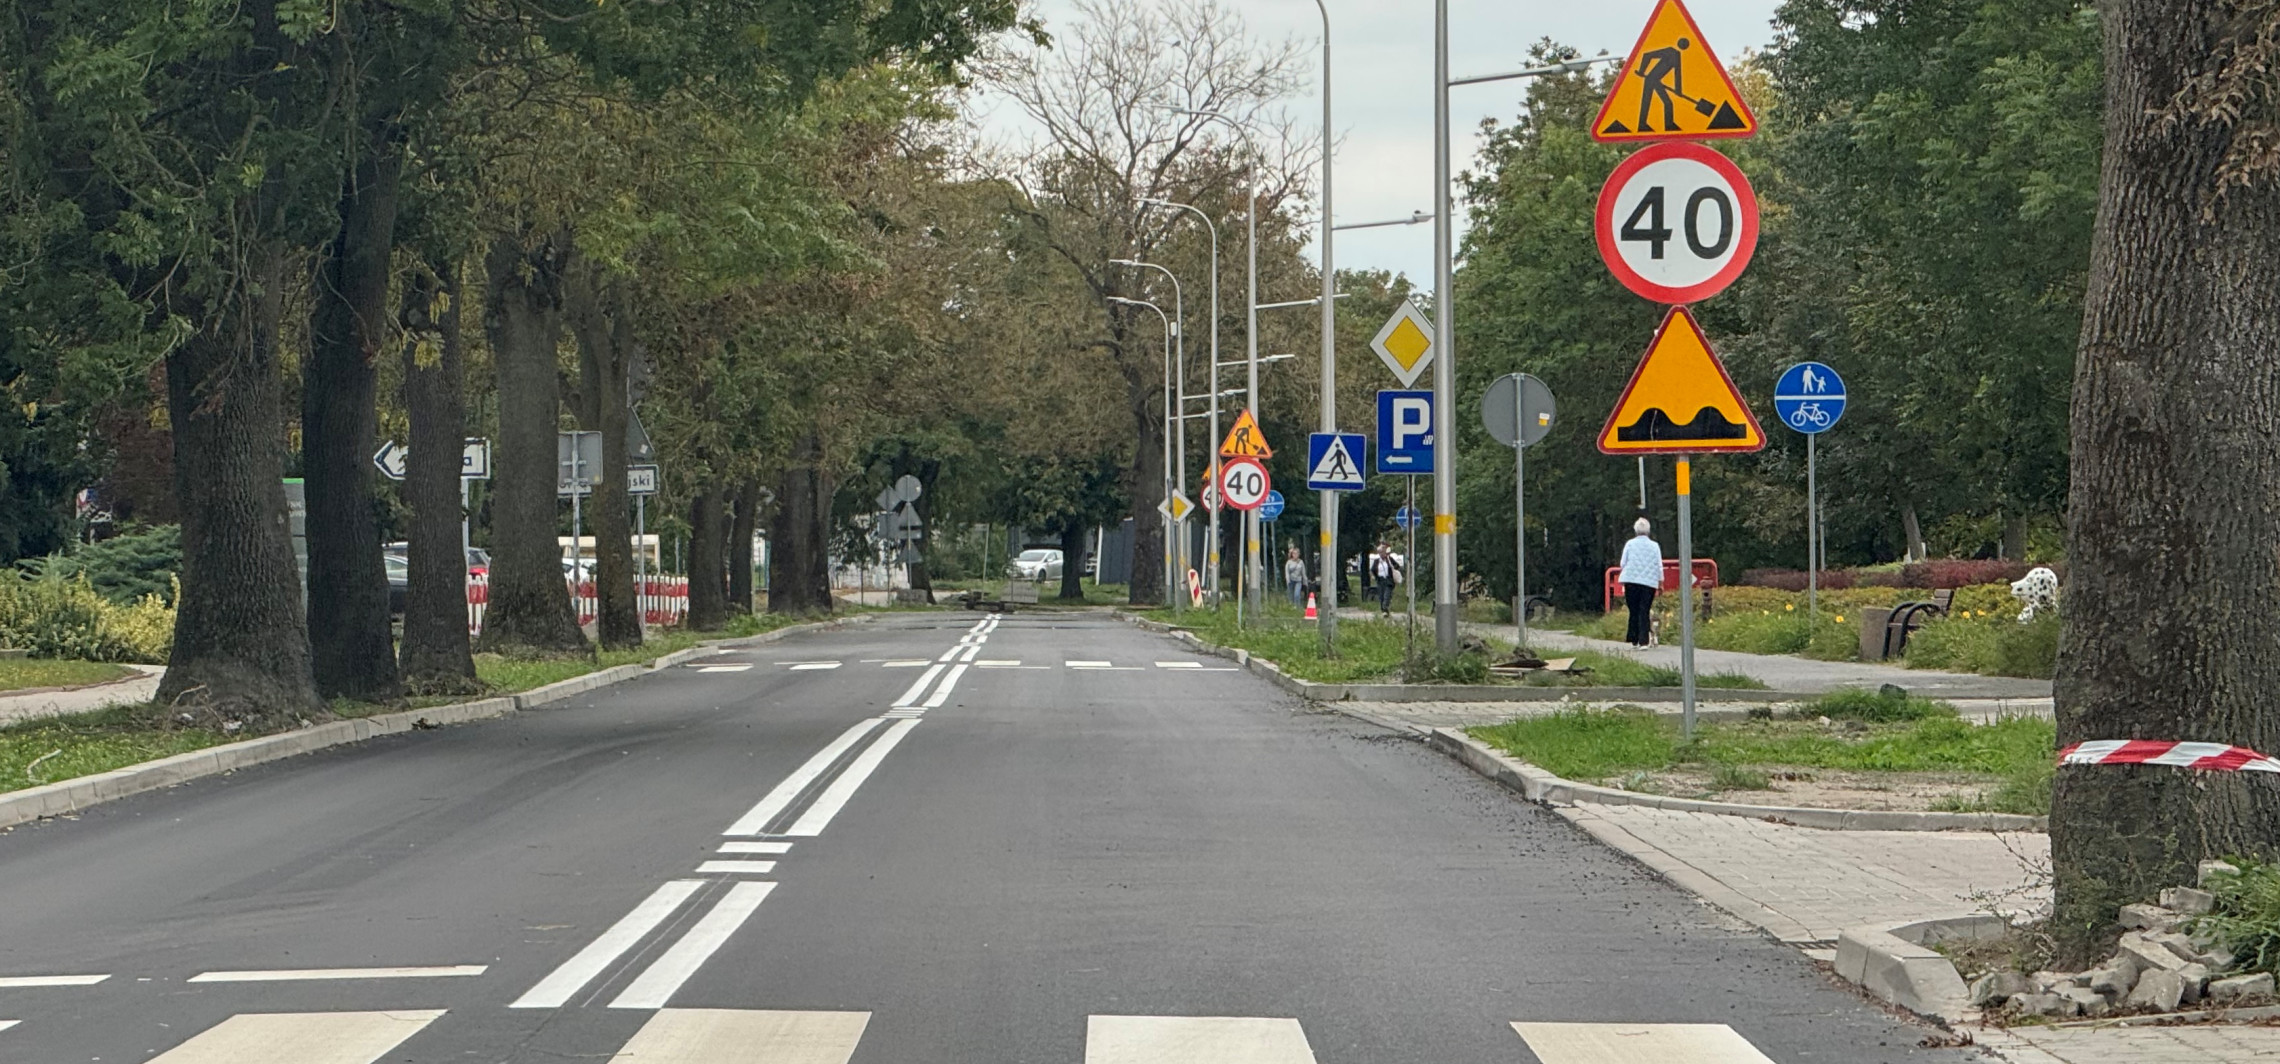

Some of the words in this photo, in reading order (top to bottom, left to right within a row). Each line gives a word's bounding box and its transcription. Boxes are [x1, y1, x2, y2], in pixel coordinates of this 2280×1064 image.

[1620, 186, 1734, 260] 40
[1393, 398, 1430, 449] P
[628, 474, 650, 488] jski
[1226, 471, 1263, 496] 40
